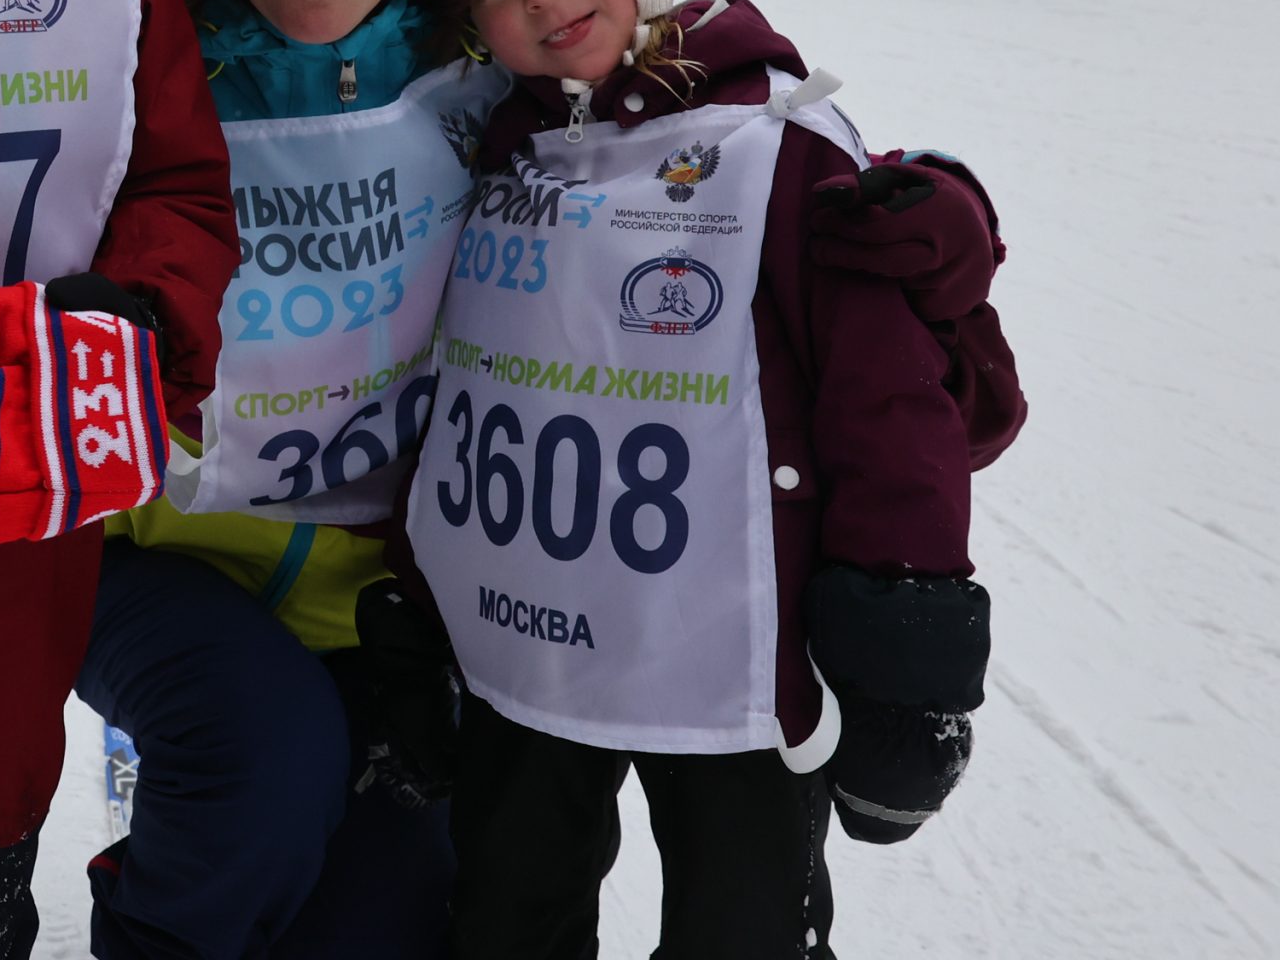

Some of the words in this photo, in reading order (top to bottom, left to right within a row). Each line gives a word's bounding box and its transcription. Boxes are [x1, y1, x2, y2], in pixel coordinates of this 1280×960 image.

[233, 211, 404, 279] РОССИИ
[610, 220, 681, 233] РОССИЙСКОЙ
[683, 224, 743, 235] ФЕДЕРАЦИИ
[615, 209, 696, 222] МИНИСТЕРСТВО
[699, 214, 738, 223] СПОРТА
[454, 227, 549, 293] 2023
[236, 264, 404, 341] 2023
[234, 385, 329, 420] СПОРТ
[493, 352, 597, 395] НОРМА
[600, 367, 730, 405] ЖИЗНИ
[249, 375, 440, 506] 360
[438, 390, 689, 573] 3608
[479, 586, 595, 649] МОСКВА
